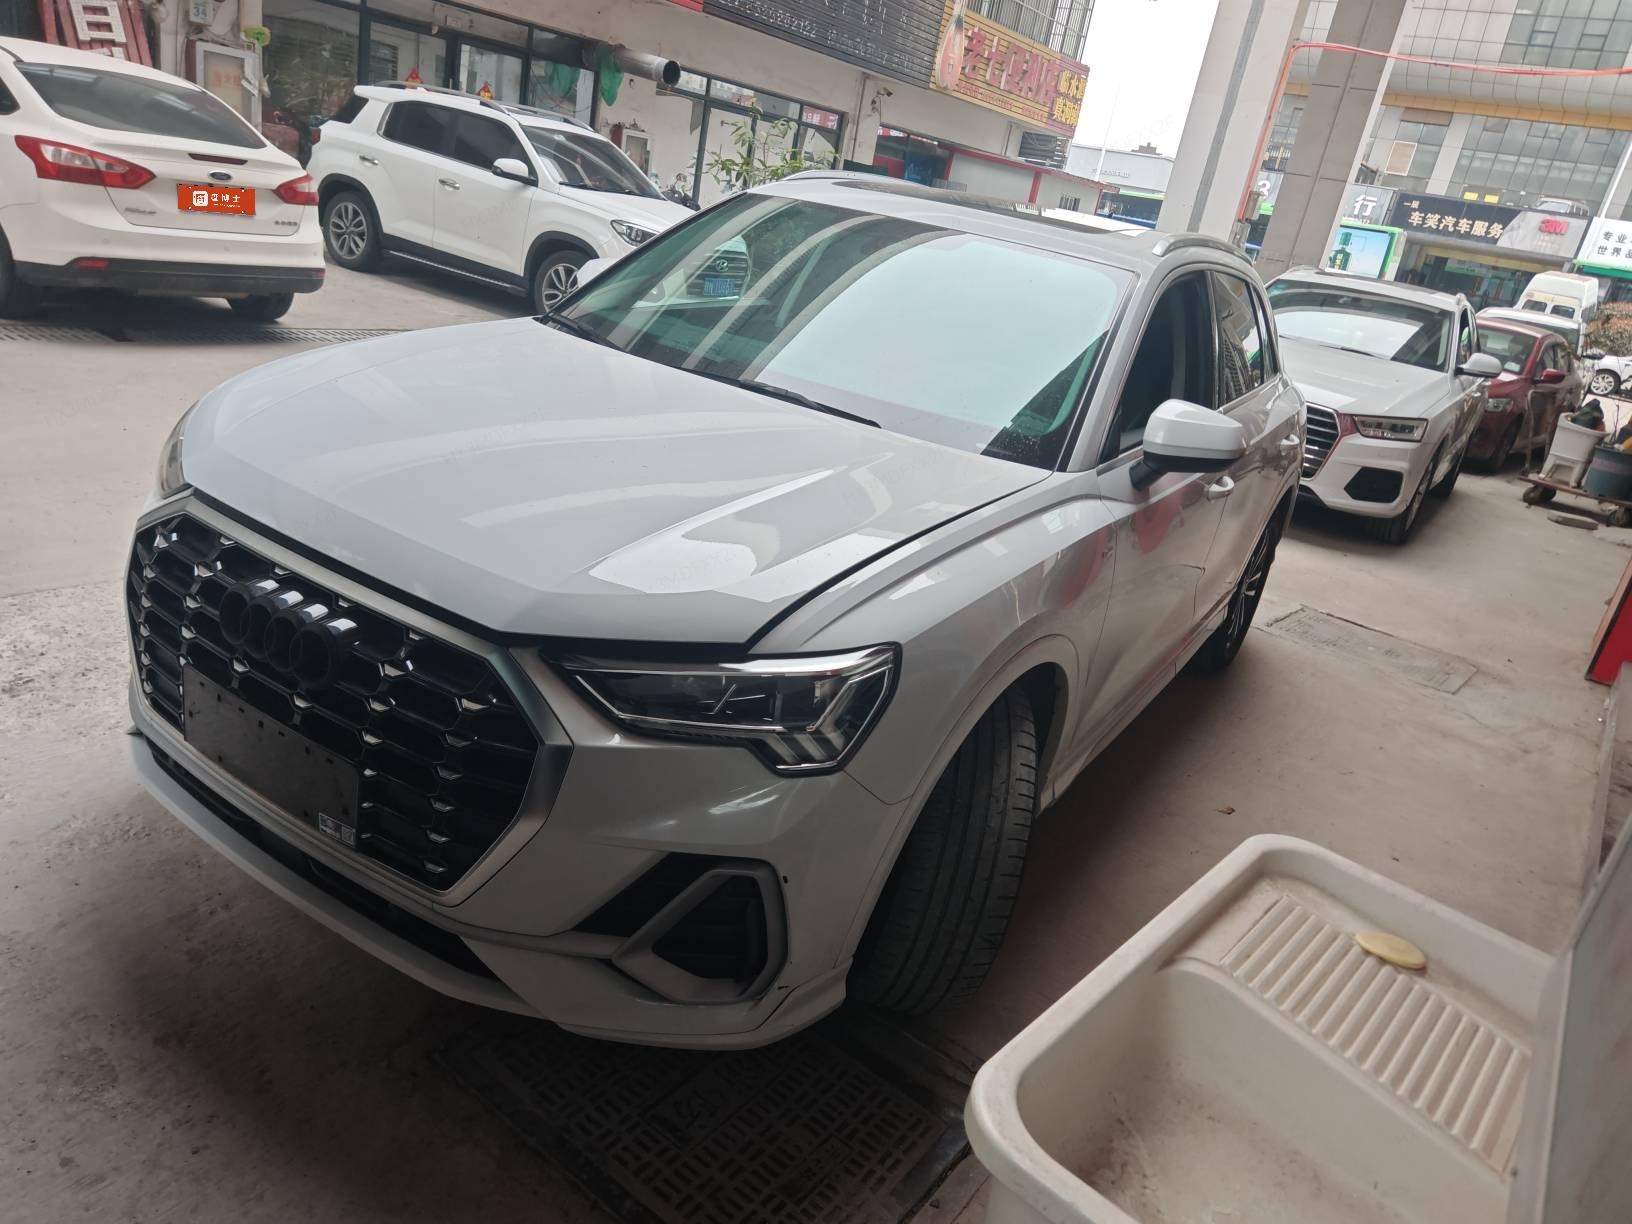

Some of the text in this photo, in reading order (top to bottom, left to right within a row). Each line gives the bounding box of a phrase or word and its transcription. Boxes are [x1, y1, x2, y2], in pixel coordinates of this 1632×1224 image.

[1353, 194, 1378, 217] 行
[1408, 210, 1504, 239] 车笑汽车服务
[1602, 230, 1632, 244] 专业
